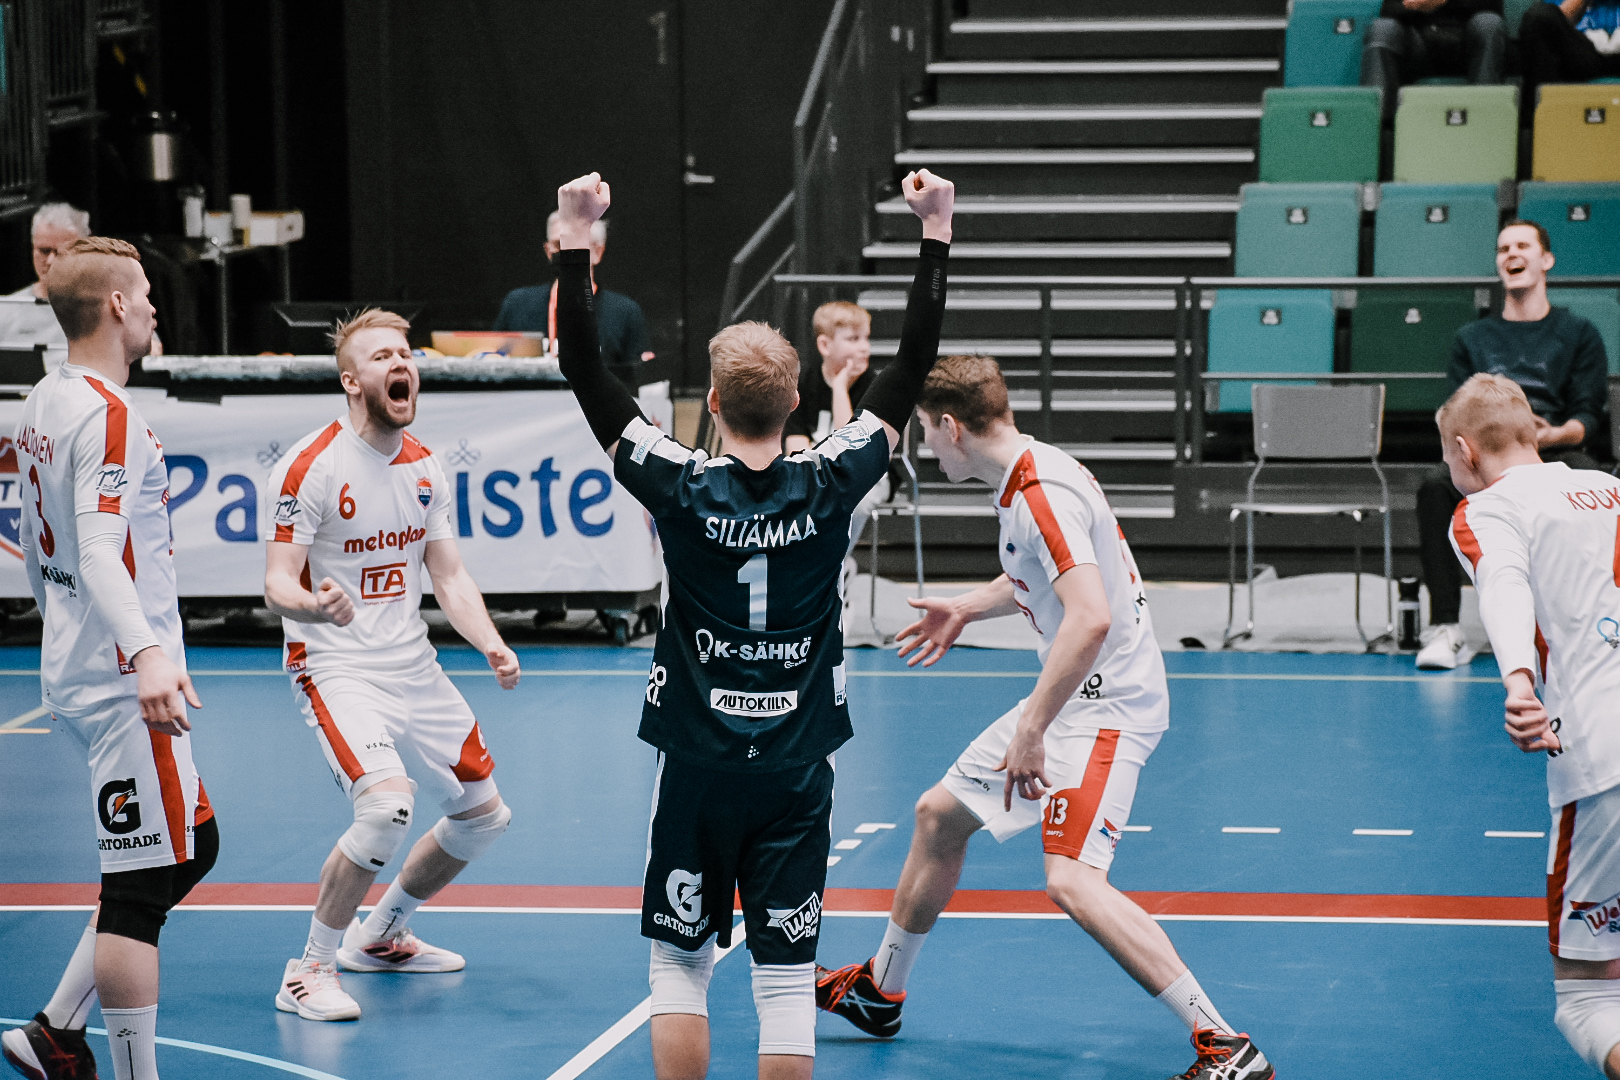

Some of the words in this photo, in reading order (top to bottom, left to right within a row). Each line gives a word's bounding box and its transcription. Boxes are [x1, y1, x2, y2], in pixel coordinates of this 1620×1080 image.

[28, 463, 56, 558] 3
[338, 483, 357, 520] 6
[704, 513, 818, 548] SILIÄMAA
[367, 569, 406, 592] TA
[737, 552, 768, 632] 1
[714, 636, 812, 661] K-SÄHKÖ
[715, 693, 793, 711] AUTOKIILA
[1048, 796, 1069, 826] 13
